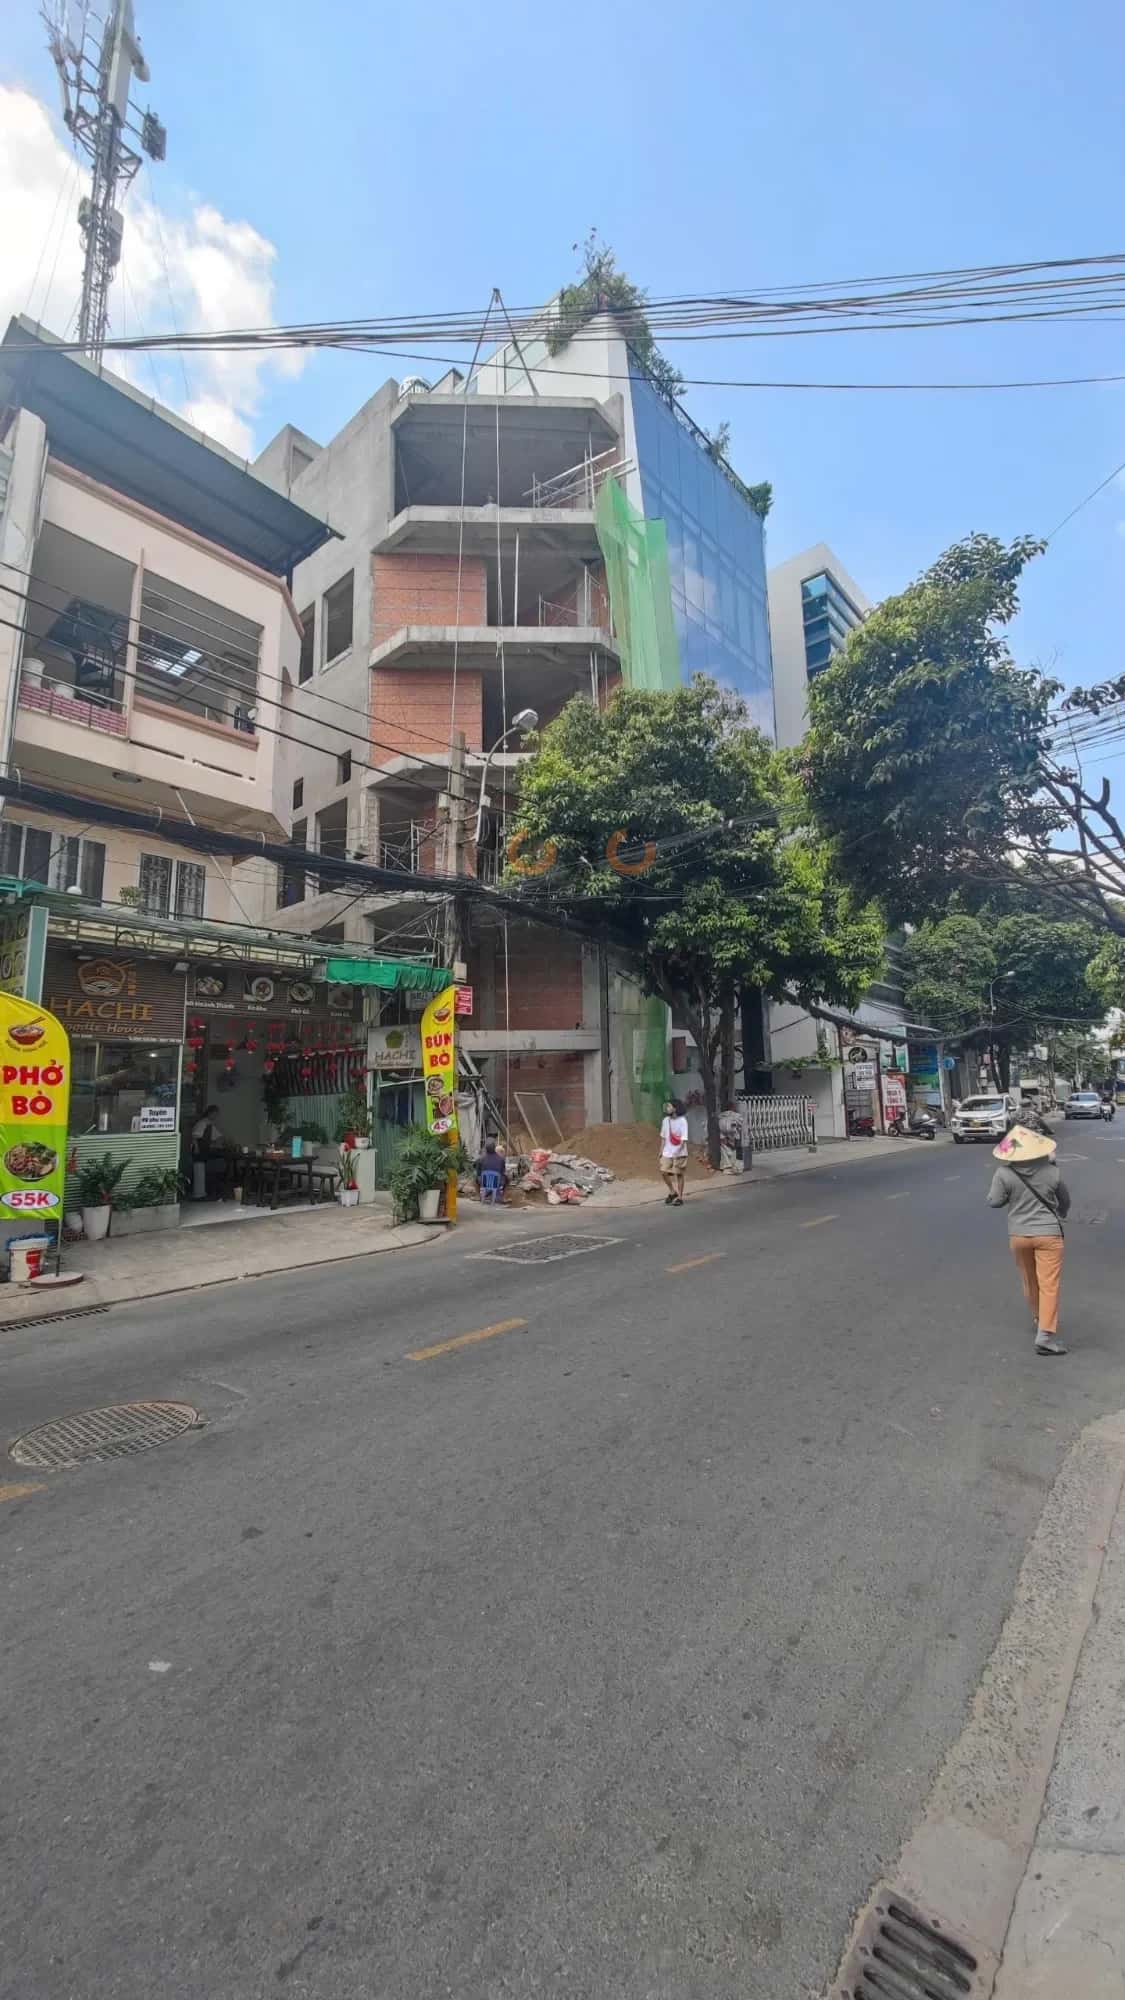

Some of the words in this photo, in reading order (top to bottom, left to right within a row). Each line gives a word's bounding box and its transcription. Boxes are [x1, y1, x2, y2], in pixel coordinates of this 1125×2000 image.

[50, 997, 153, 1021] HACHI
[375, 1049, 416, 1061] HACHI
[430, 1049, 450, 1068] BÒ
[3, 1059, 64, 1086] PHỞ
[12, 1089, 53, 1116] BÒ
[11, 1193, 49, 1206] 55K
